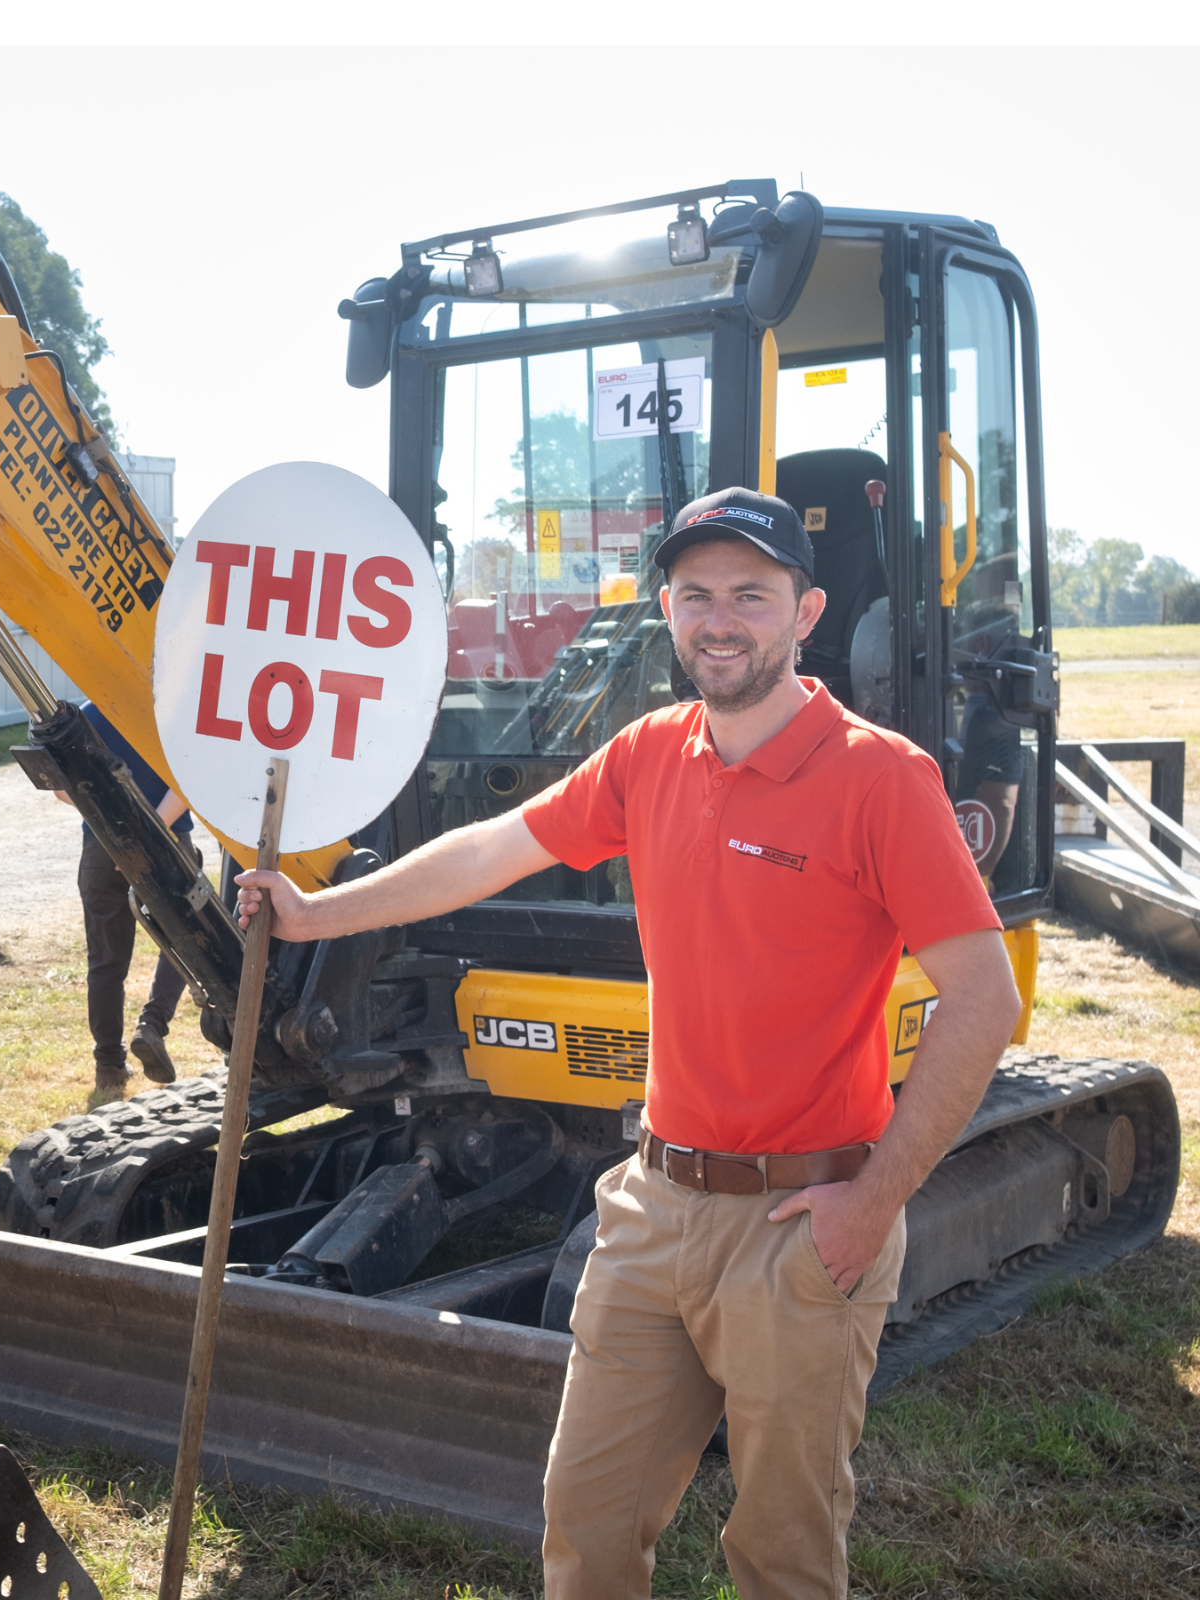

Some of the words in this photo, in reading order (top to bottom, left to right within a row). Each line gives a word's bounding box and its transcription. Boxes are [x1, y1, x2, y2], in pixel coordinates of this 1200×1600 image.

[598, 373, 628, 384] EURO
[628, 371, 652, 379] AUCTIONS
[616, 388, 683, 428] 145
[3, 419, 64, 502] PLANT
[60, 503, 105, 568] HIRE
[102, 565, 136, 614] LTD
[687, 509, 725, 526] EURO
[725, 509, 767, 523] AUCTIONS
[90, 499, 155, 590] CASEY
[33, 501, 71, 558] 022
[68, 555, 123, 633] 21179
[196, 540, 414, 648] THIS
[195, 652, 384, 761] LOT
[728, 838, 762, 855] EURO
[762, 849, 799, 866] AUCTIONS
[476, 1018, 556, 1050] JCB
[904, 1017, 918, 1038] JCB
